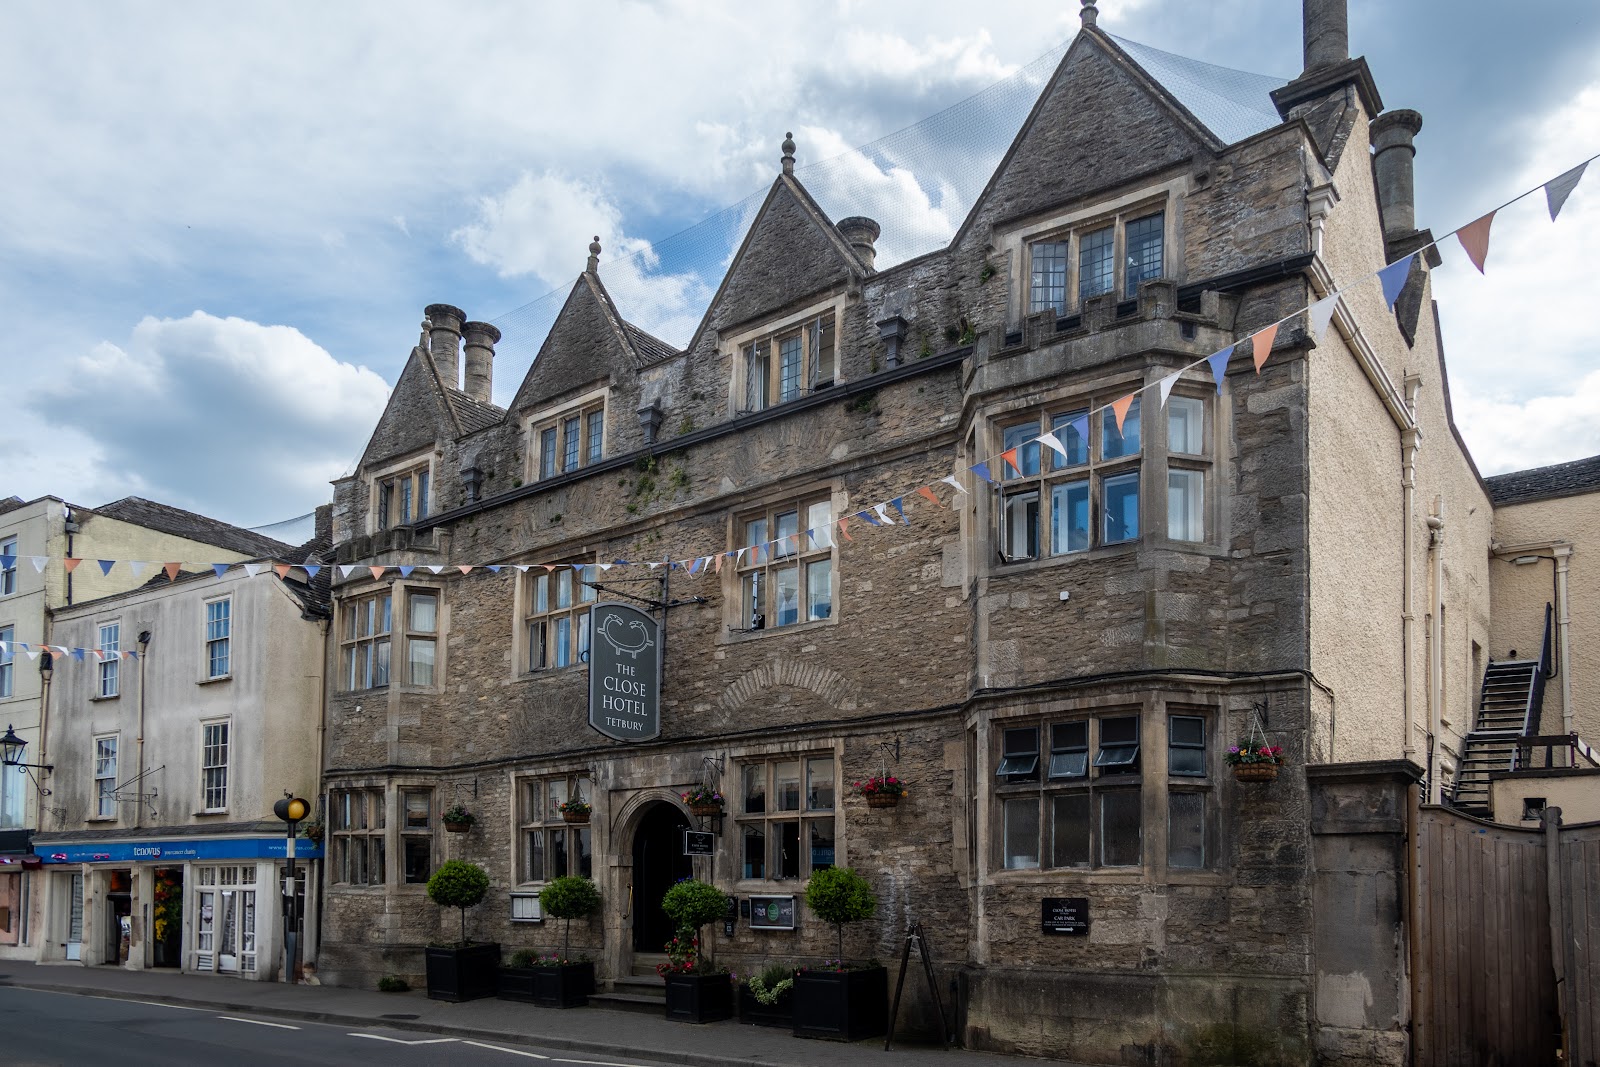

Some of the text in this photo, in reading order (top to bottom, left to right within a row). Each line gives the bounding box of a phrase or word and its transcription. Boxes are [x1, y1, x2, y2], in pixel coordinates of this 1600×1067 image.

[616, 663, 635, 676] THE
[603, 676, 646, 697] CLOSE
[602, 695, 648, 716] HOTEL
[606, 716, 644, 731] TETBURY
[133, 847, 161, 856] tenovus
